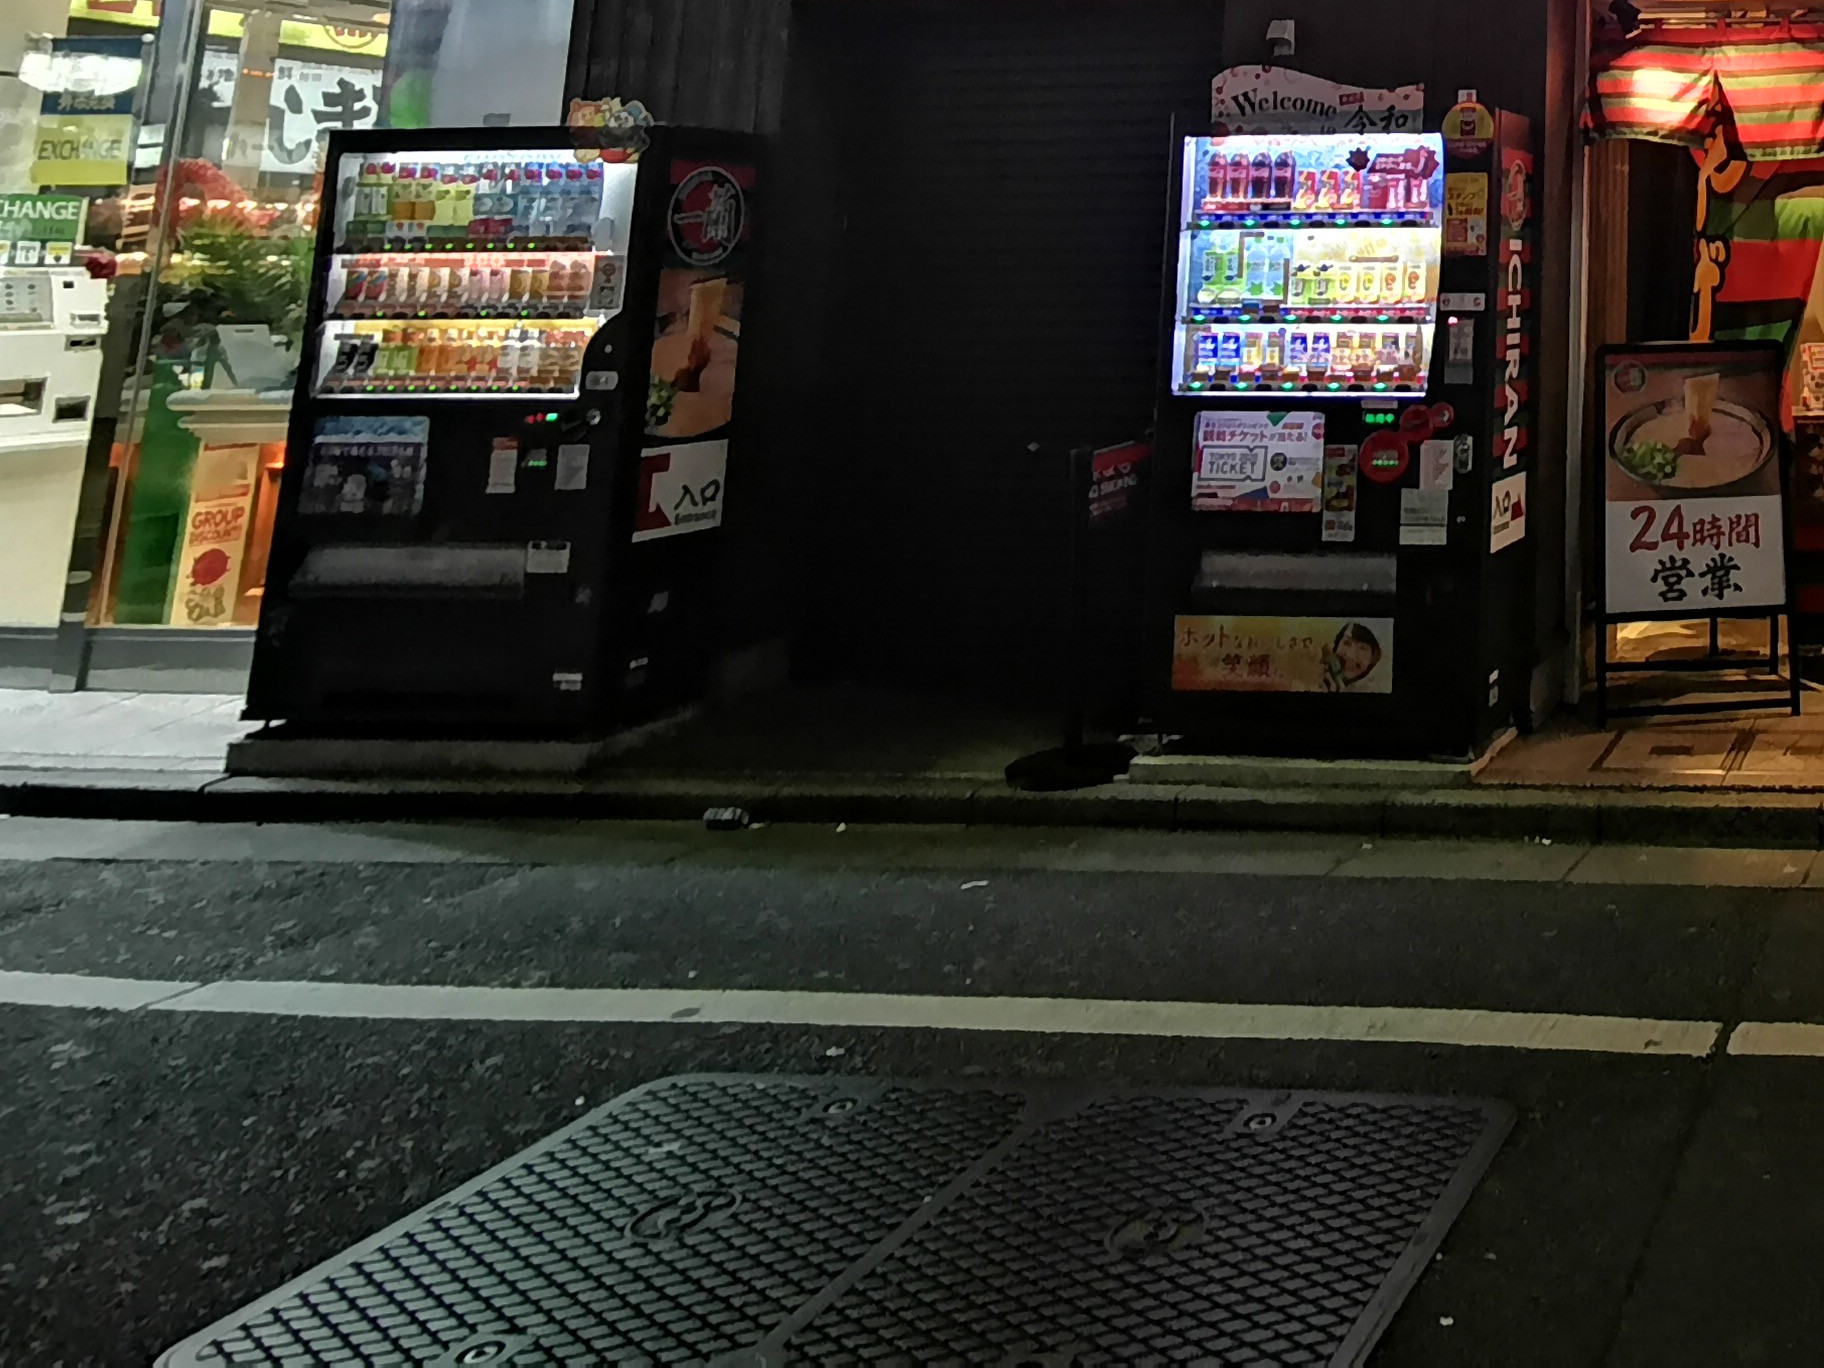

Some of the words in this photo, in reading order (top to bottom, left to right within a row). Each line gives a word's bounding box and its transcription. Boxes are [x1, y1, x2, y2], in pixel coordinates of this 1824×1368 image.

[1231, 88, 1337, 118] Welcome
[1503, 238, 1524, 469] ICHIRAN
[1208, 462, 1257, 475] TICKET
[191, 505, 246, 530] GROUP
[1629, 503, 1761, 554] 24時間
[1650, 552, 1744, 603] 営業
